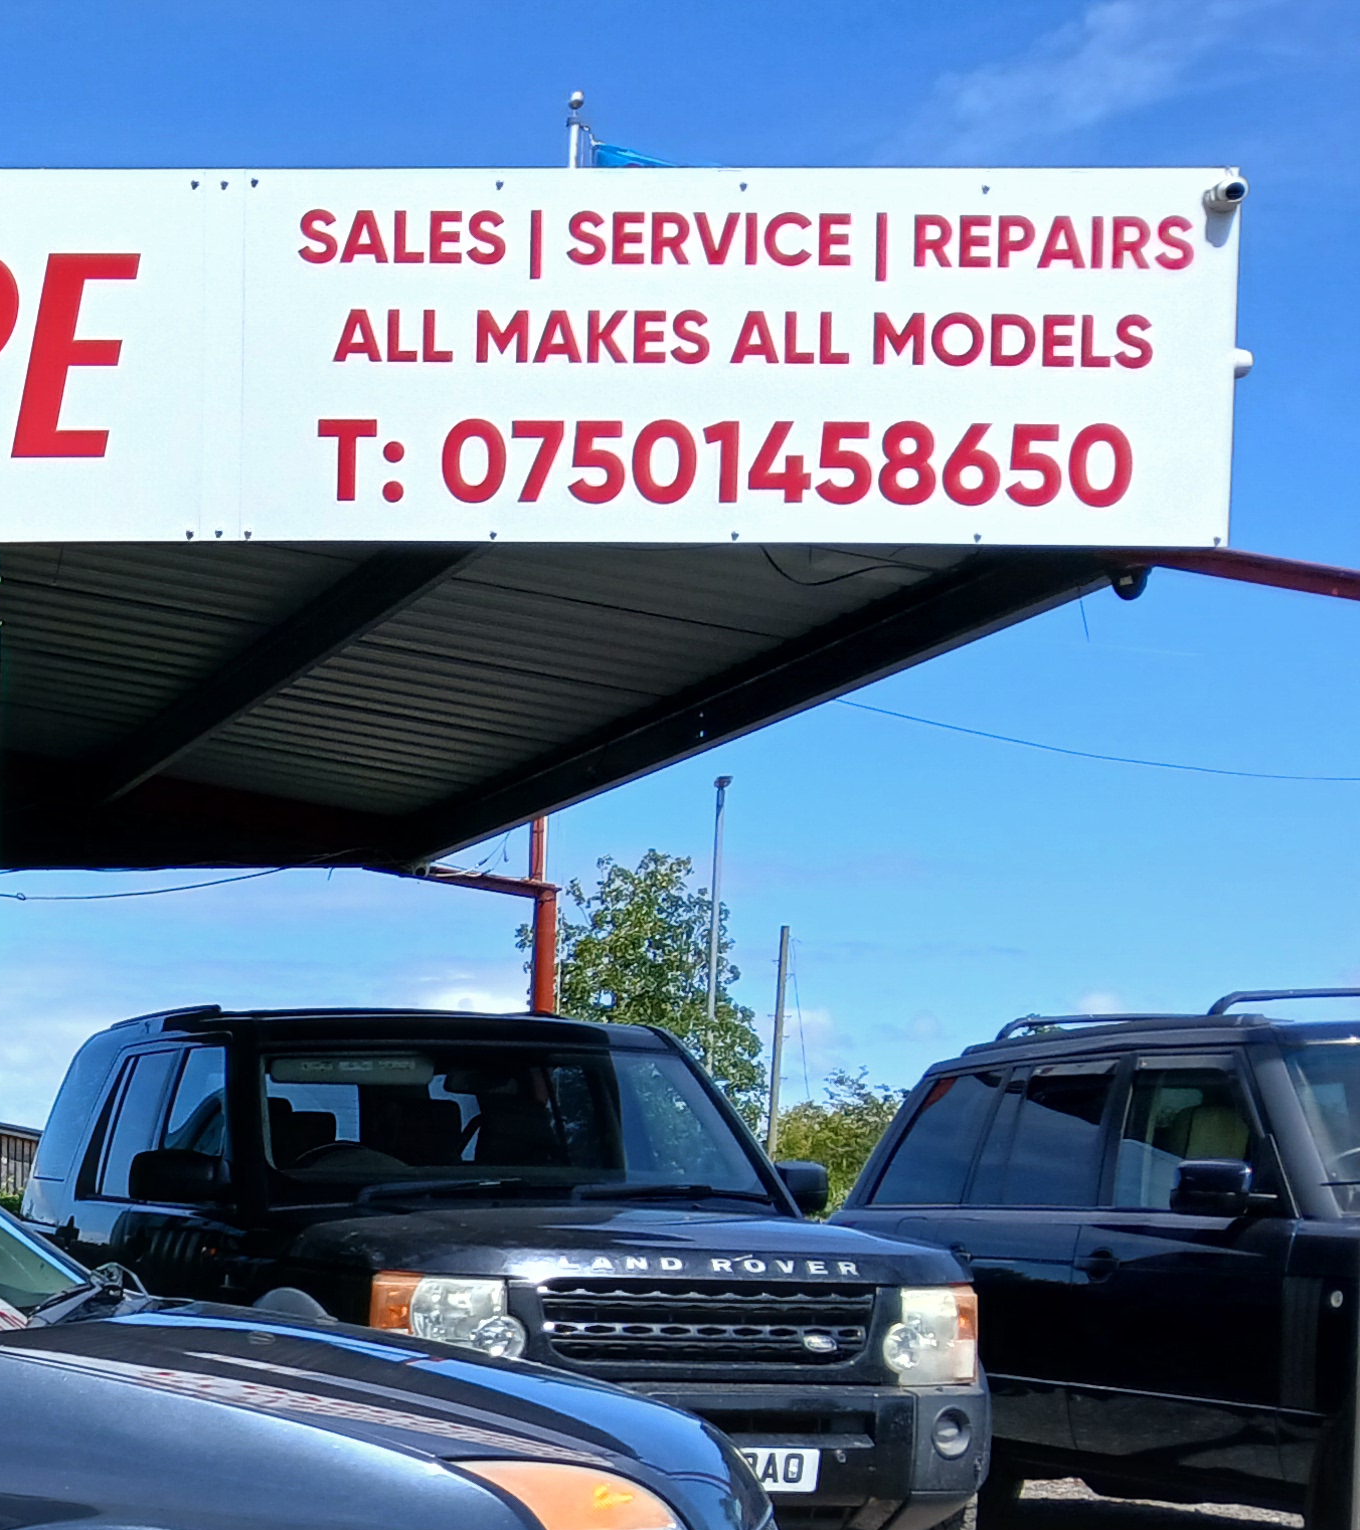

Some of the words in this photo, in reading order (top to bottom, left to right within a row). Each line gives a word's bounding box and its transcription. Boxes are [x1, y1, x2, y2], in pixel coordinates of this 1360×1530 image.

[298, 209, 507, 265] SALES
[567, 212, 853, 268] SERVICE
[914, 215, 1196, 272] REPAIRS
[334, 309, 454, 364] ALL
[477, 310, 711, 365] MAKES
[732, 312, 850, 367] ALL
[874, 313, 1154, 370] MODELS
[317, 419, 406, 502] T:
[441, 418, 1135, 508] 07501458650
[559, 1255, 684, 1272] LAND
[711, 1258, 860, 1276] ROVER
